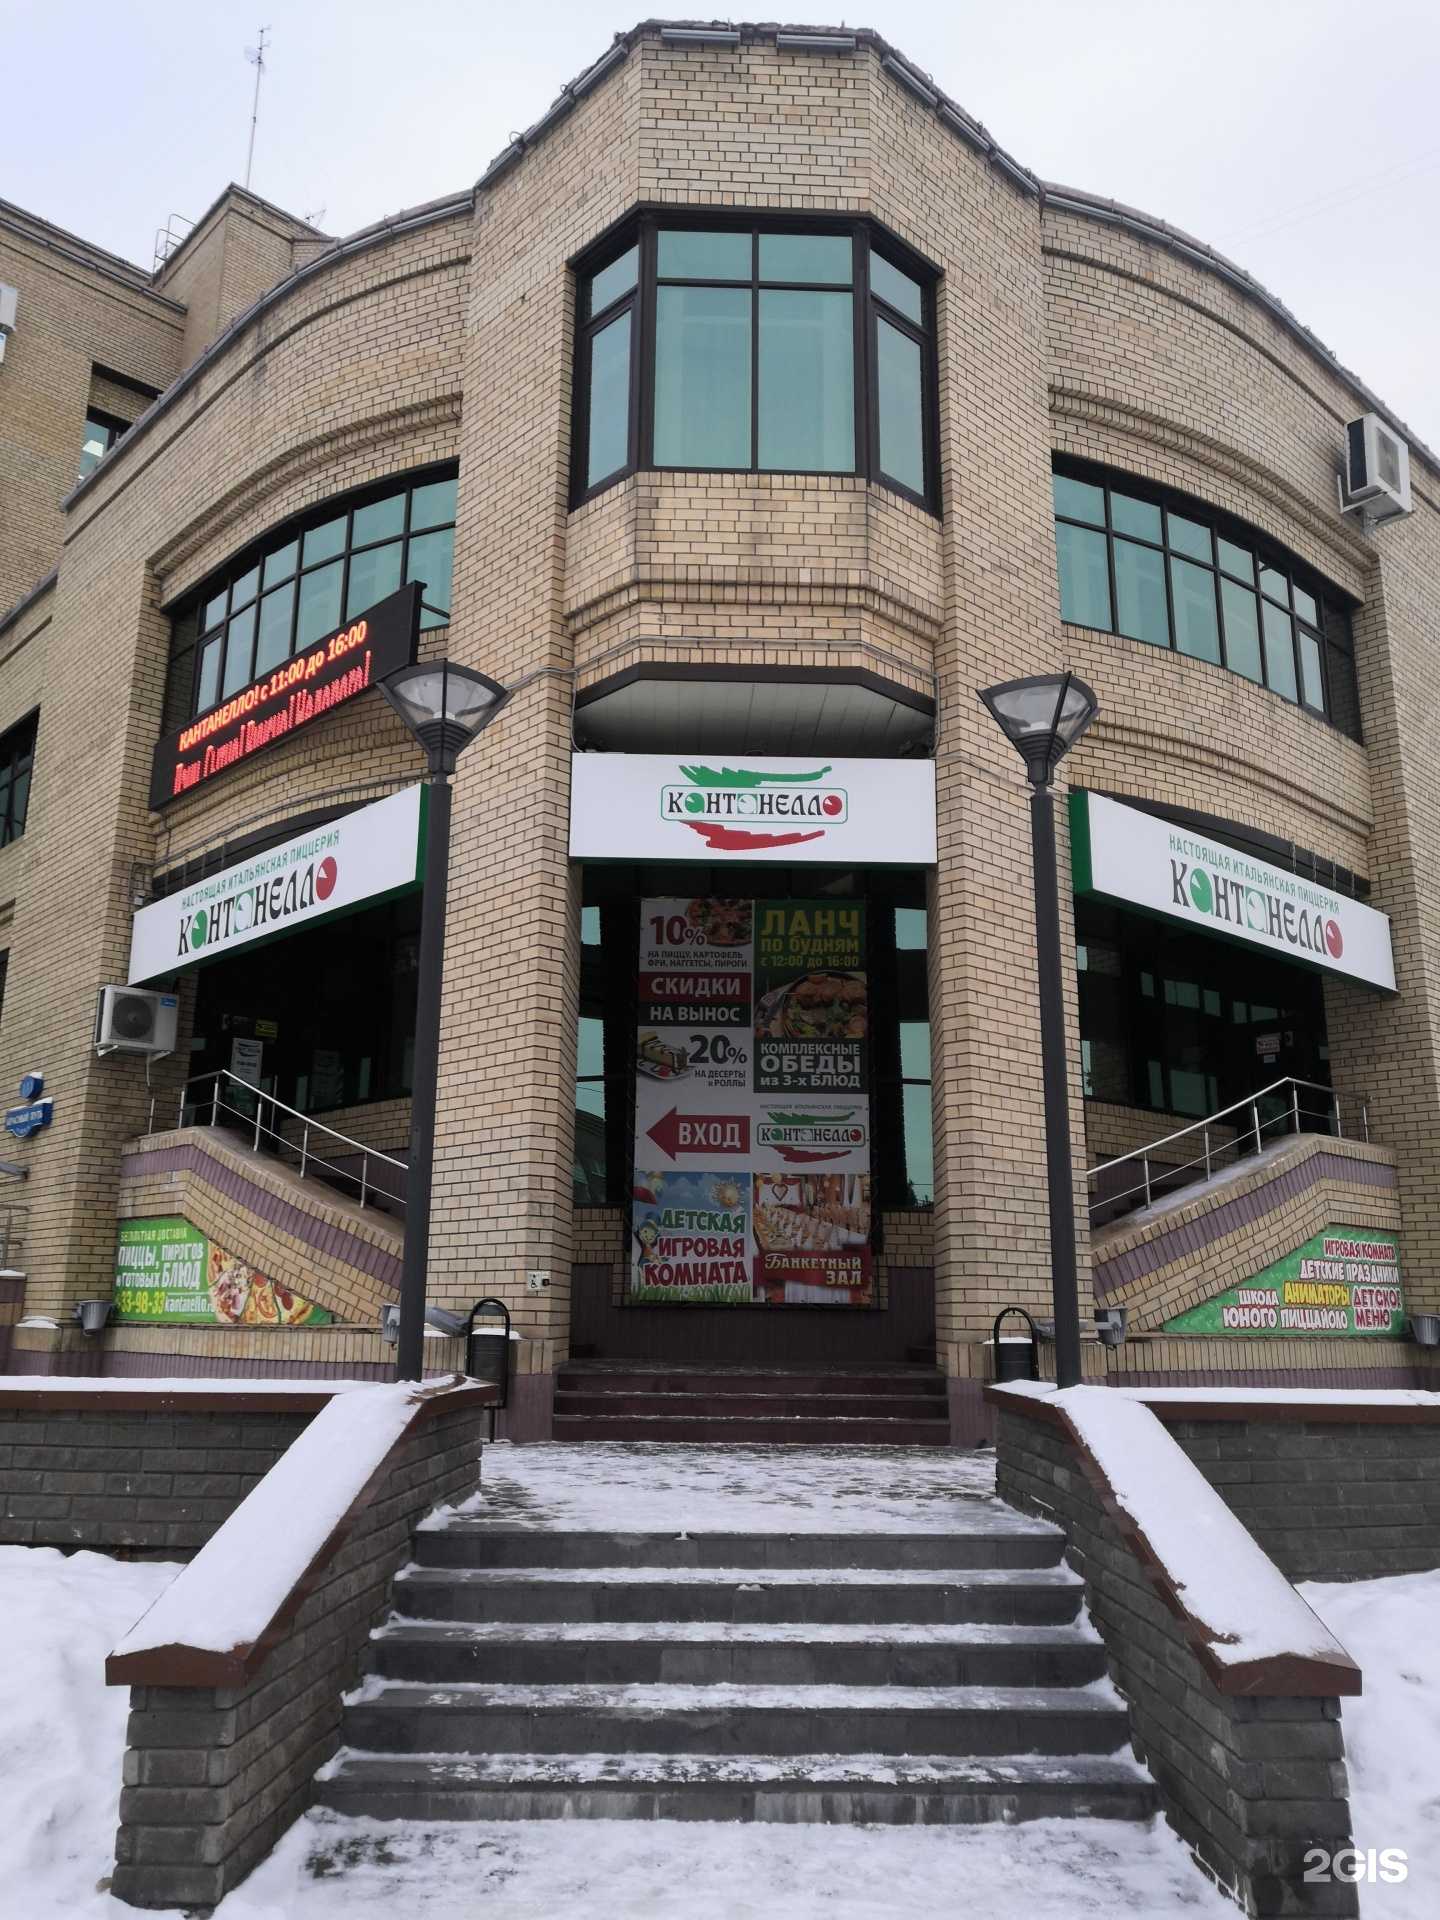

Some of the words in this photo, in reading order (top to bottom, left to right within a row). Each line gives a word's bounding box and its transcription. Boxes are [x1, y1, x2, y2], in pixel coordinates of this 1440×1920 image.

[179, 685, 260, 752] КАНТАНЕЛЛО!
[269, 659, 305, 695] 11:00
[305, 651, 325, 679] до
[327, 620, 367, 661] 16:00
[181, 877, 226, 909] НАСТОЯЩАЯ
[227, 851, 288, 891] ИТАЛЬЯНСКАЯ
[290, 829, 340, 866] ПИЦЦЕРИЯ
[1169, 834, 1231, 872] НАСТОЯЩАЯ
[1233, 856, 1296, 896] ИТАЛЬЯНСКАЯ
[1298, 885, 1341, 914] ПИЦЦЕРИЯ
[650, 915, 705, 945] 10%
[760, 910, 859, 936] ЛАНЧ
[693, 951, 743, 959] КАРТОФЕЛЬ
[790, 936, 859, 955] будням
[770, 955, 803, 967] 12:00
[807, 957, 822, 968] до
[651, 977, 741, 998] СКИДКИ
[650, 1007, 673, 1021] НА
[678, 1007, 740, 1021] ВЫНОС
[689, 1034, 748, 1064] 20%
[761, 1044, 860, 1055] КОМПЛЕКСНЫЕ
[695, 1070, 706, 1078] НА
[708, 1070, 746, 1079] ДЕСЕРТЫ
[761, 1056, 860, 1074] ОБЕДЫ
[811, 1075, 861, 1088] БЛЮД
[679, 1122, 740, 1148] ВХОД
[660, 1209, 746, 1233] ДЕТСКАЯ
[118, 1245, 160, 1269] ПИЦЦЫ,
[162, 1243, 203, 1260] ПИРОГОВ
[658, 1238, 745, 1257] ИГРОВАЯ
[1325, 1240, 1361, 1258] ИГРОВАЯ
[122, 1272, 160, 1288] ГОТОВЫХ
[161, 1261, 201, 1290] БЛЮД
[644, 1261, 749, 1286] КОМНАТА
[826, 1271, 862, 1285] ЗАЛ
[1300, 1260, 1344, 1280] ДЕТСКИЕ
[1346, 1264, 1399, 1283] ПРАЗДНИКИ
[1238, 1290, 1278, 1306] ШКОЛА
[1284, 1282, 1350, 1306] АНИМАТОРЫ
[1224, 1307, 1277, 1328] ЮНОГО
[1281, 1309, 1347, 1329] ПИЦЦАЙОЛО
[1354, 1310, 1391, 1328] МЕНЮ
